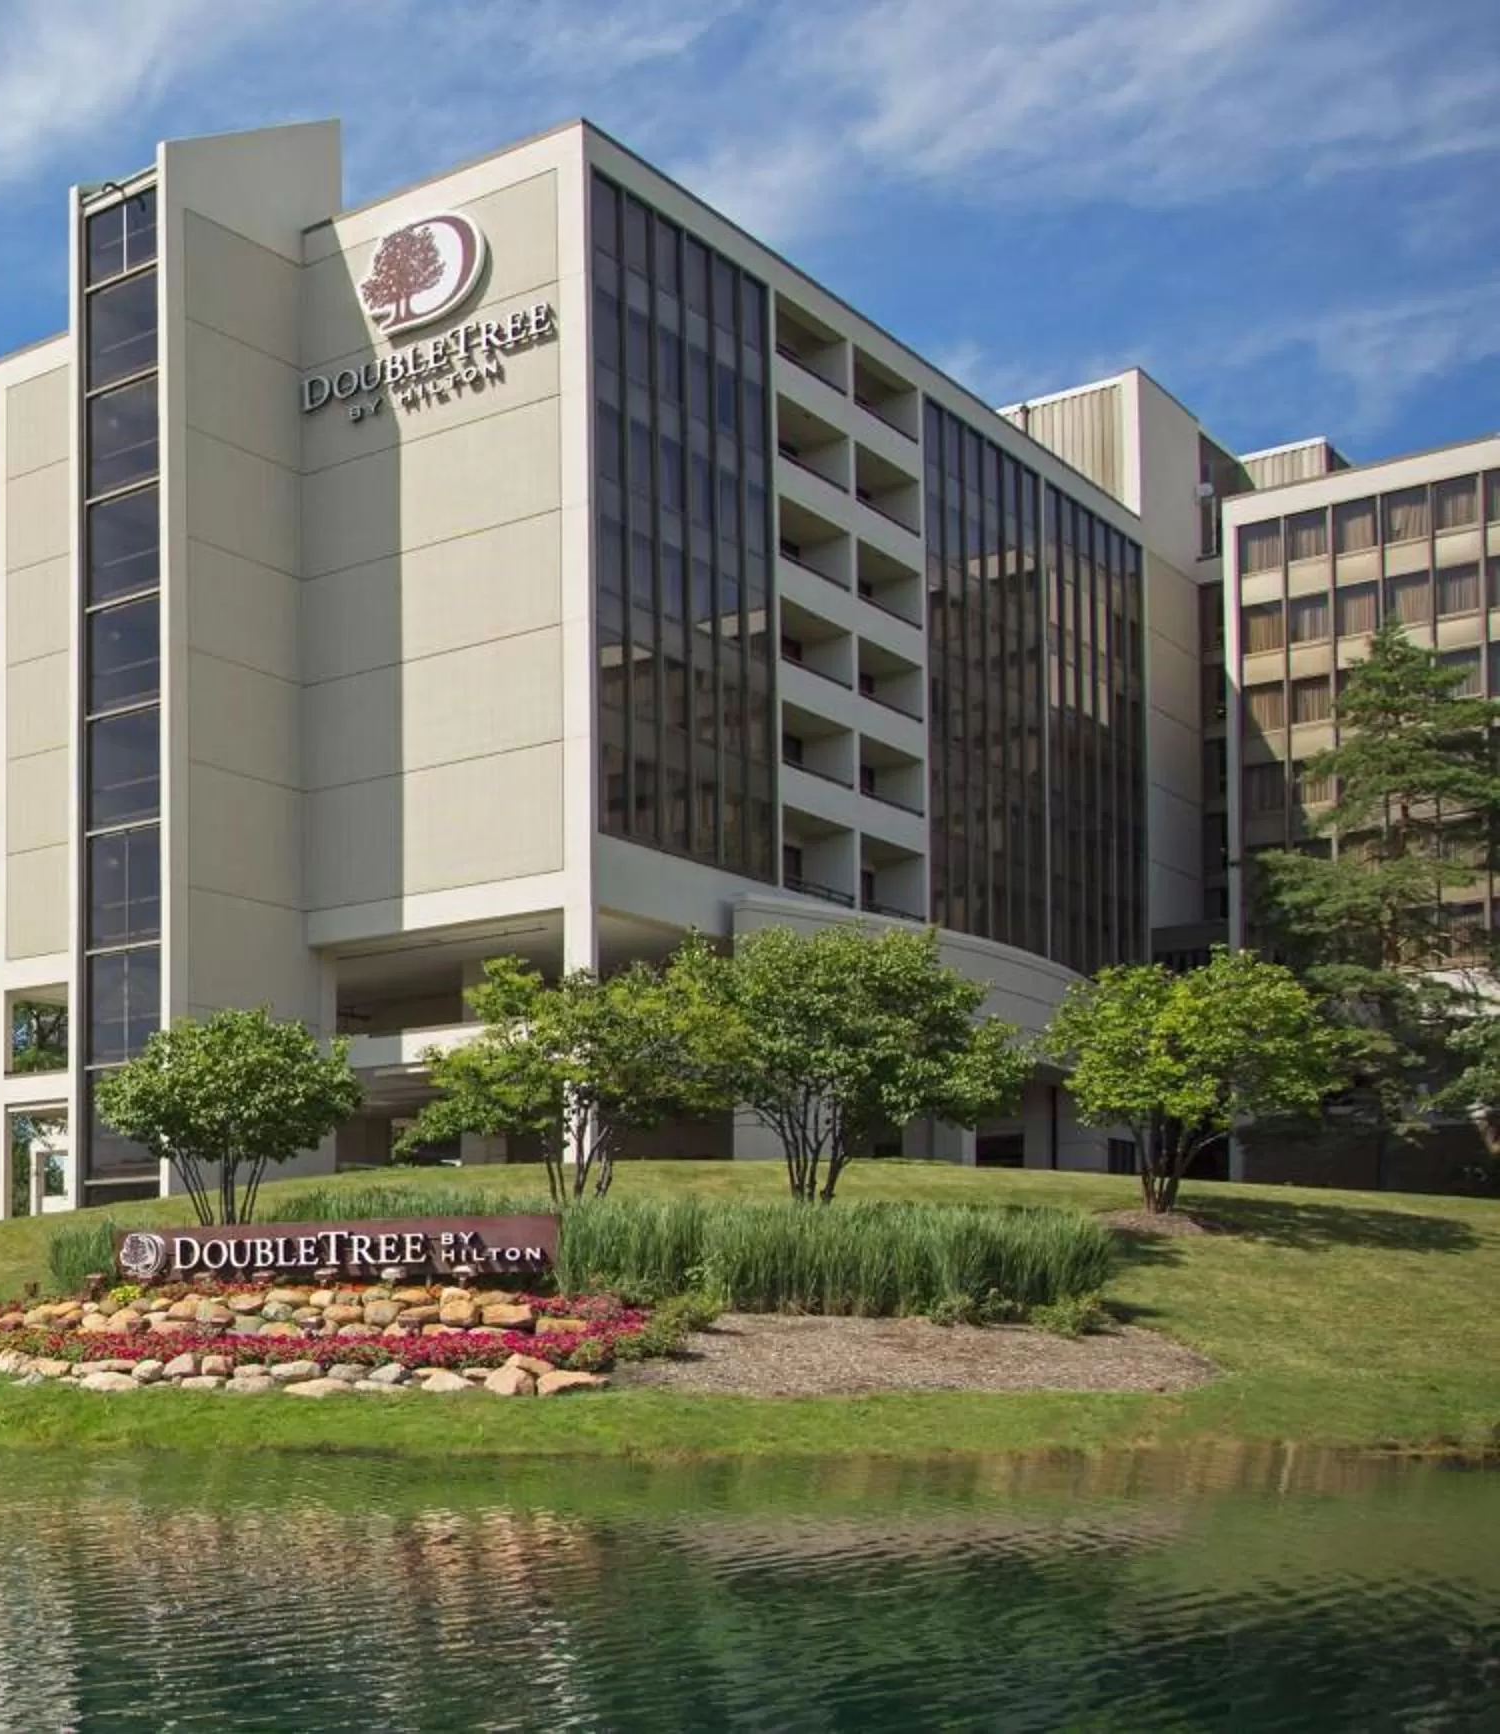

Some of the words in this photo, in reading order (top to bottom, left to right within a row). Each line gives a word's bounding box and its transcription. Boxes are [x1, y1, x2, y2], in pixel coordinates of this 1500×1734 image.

[302, 302, 552, 412] DOUBLETREE
[350, 398, 382, 421] BY
[401, 358, 499, 401] HILTON
[173, 1231, 426, 1269] DOUBLETREE
[441, 1231, 474, 1245] BY
[441, 1247, 541, 1262] HILTON
